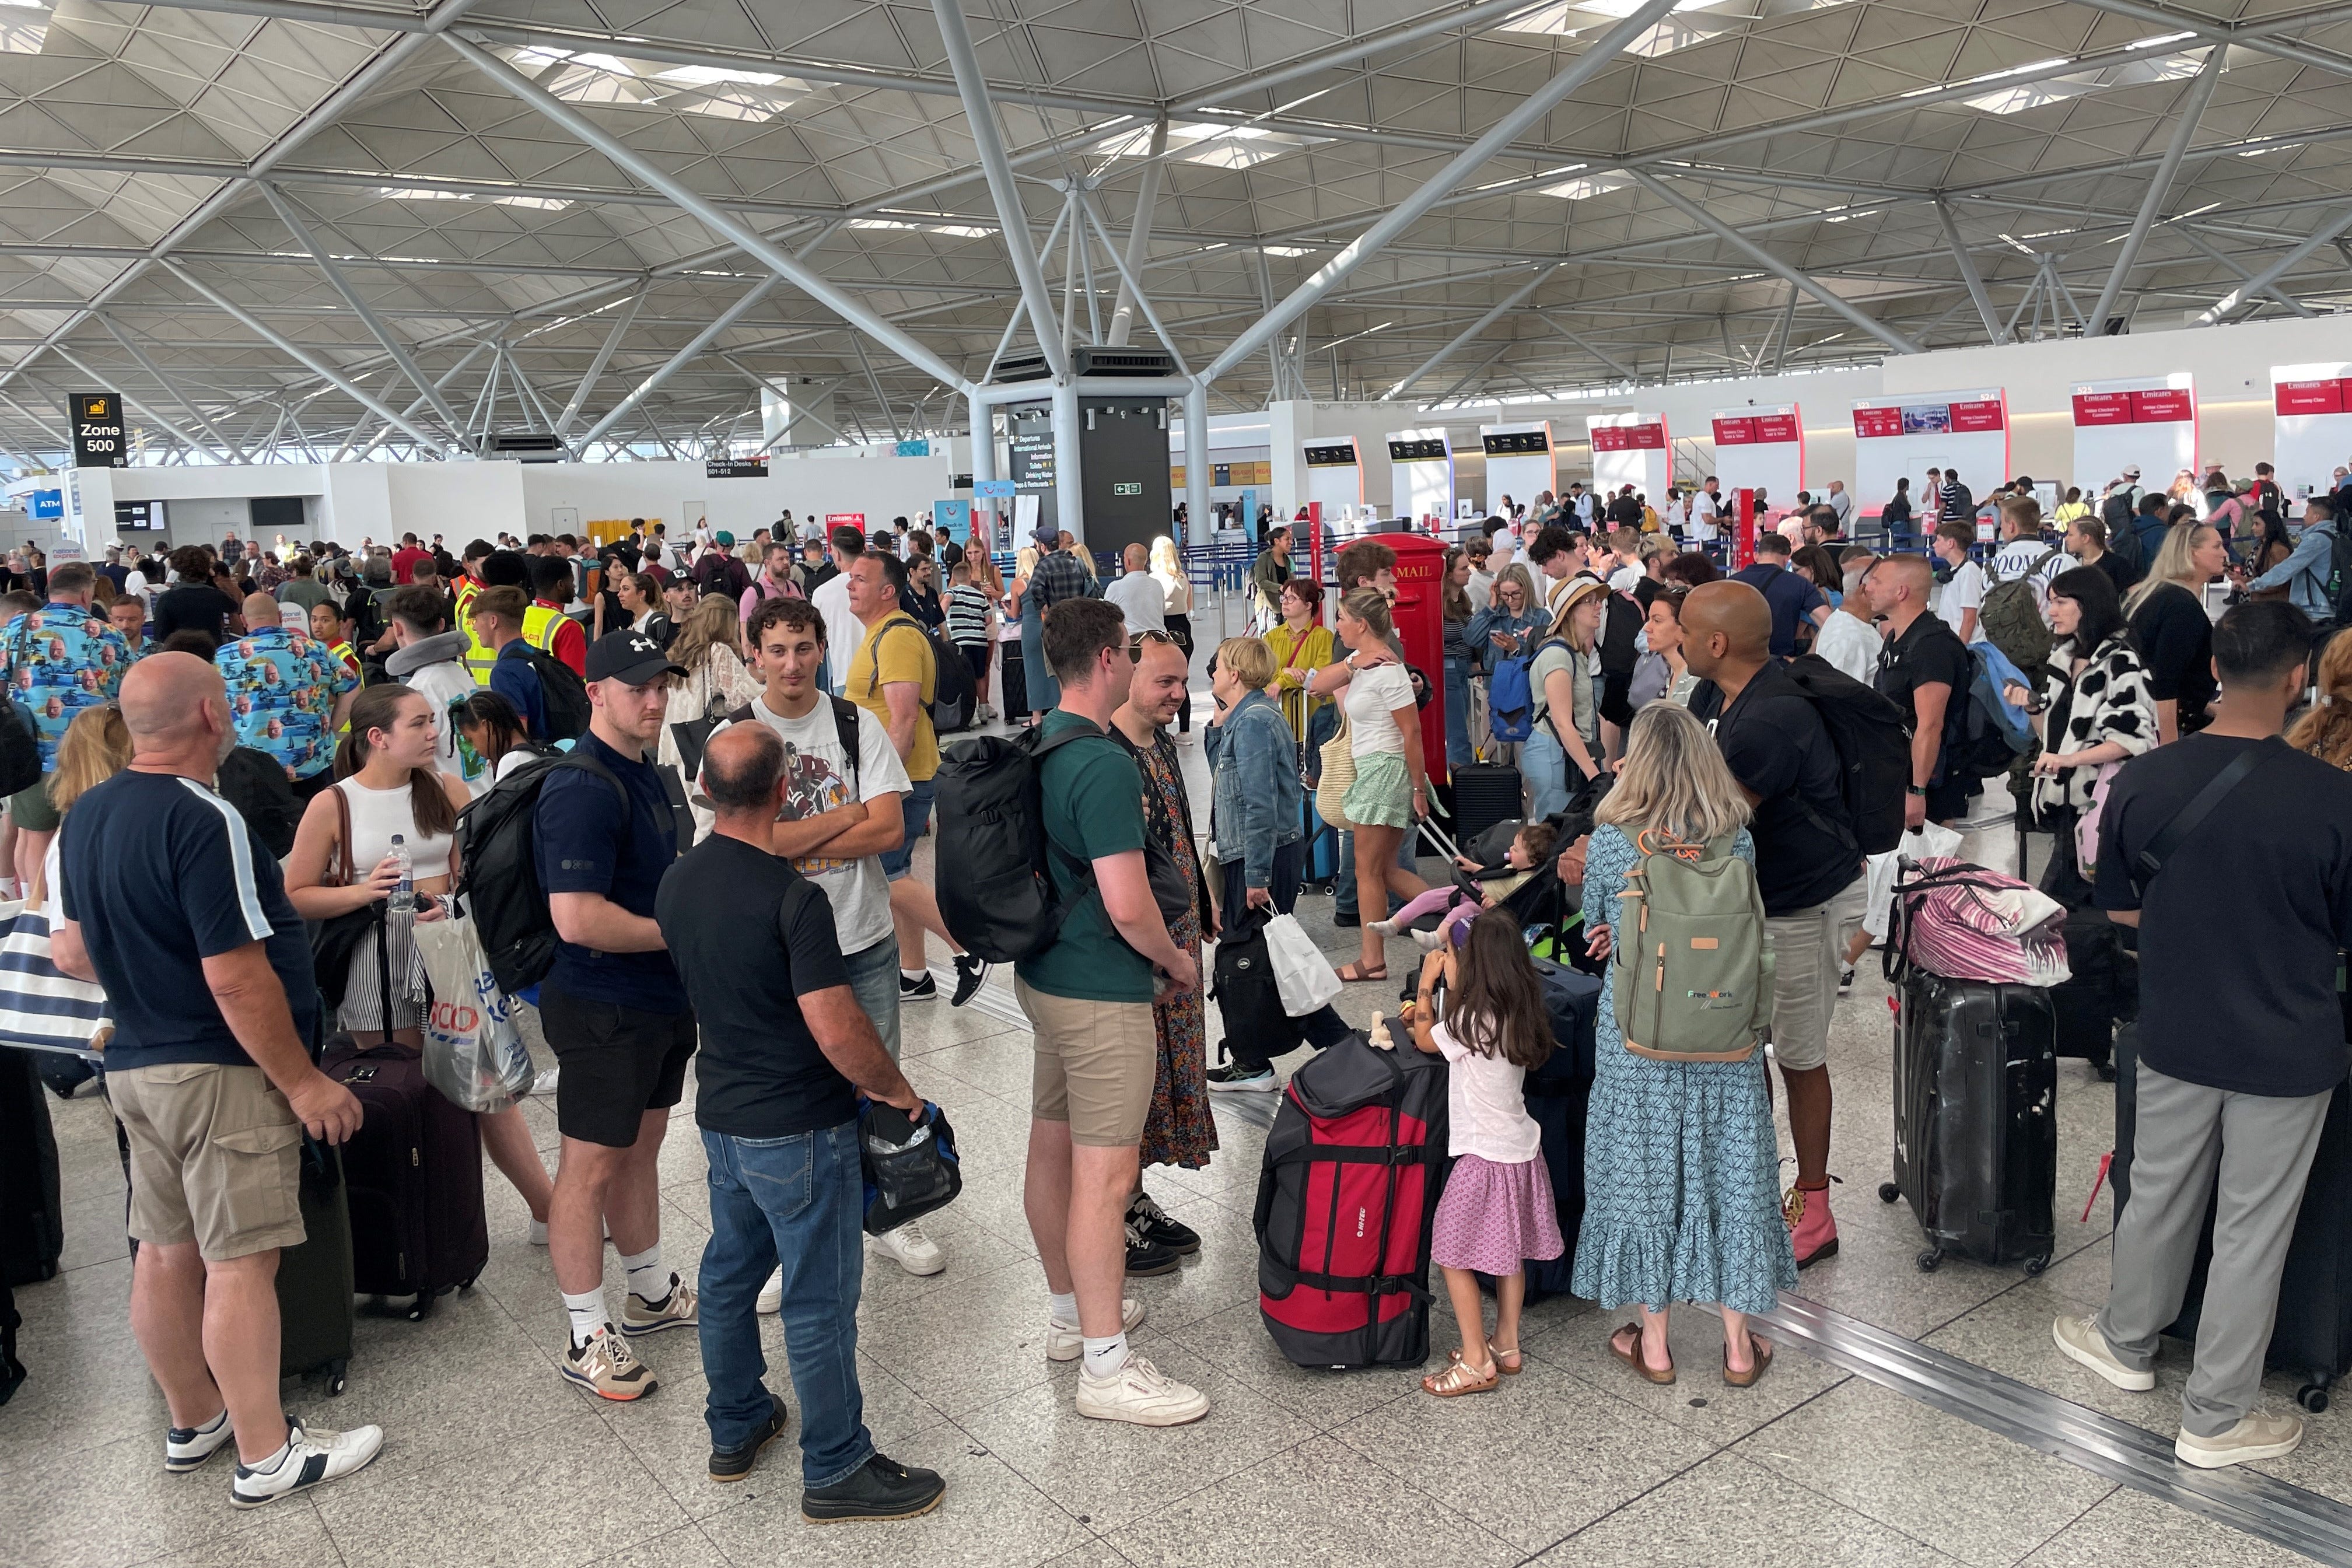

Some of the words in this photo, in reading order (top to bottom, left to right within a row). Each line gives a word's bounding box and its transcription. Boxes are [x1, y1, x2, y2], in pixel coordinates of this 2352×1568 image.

[2077, 386, 2092, 394] 525
[2142, 390, 2172, 399] Emirates
[2084, 394, 2113, 402] Emirates
[80, 424, 120, 436] Zone
[87, 440, 114, 452] 500
[40, 500, 60, 508] ATM
[1396, 565, 1433, 578] MAIL
